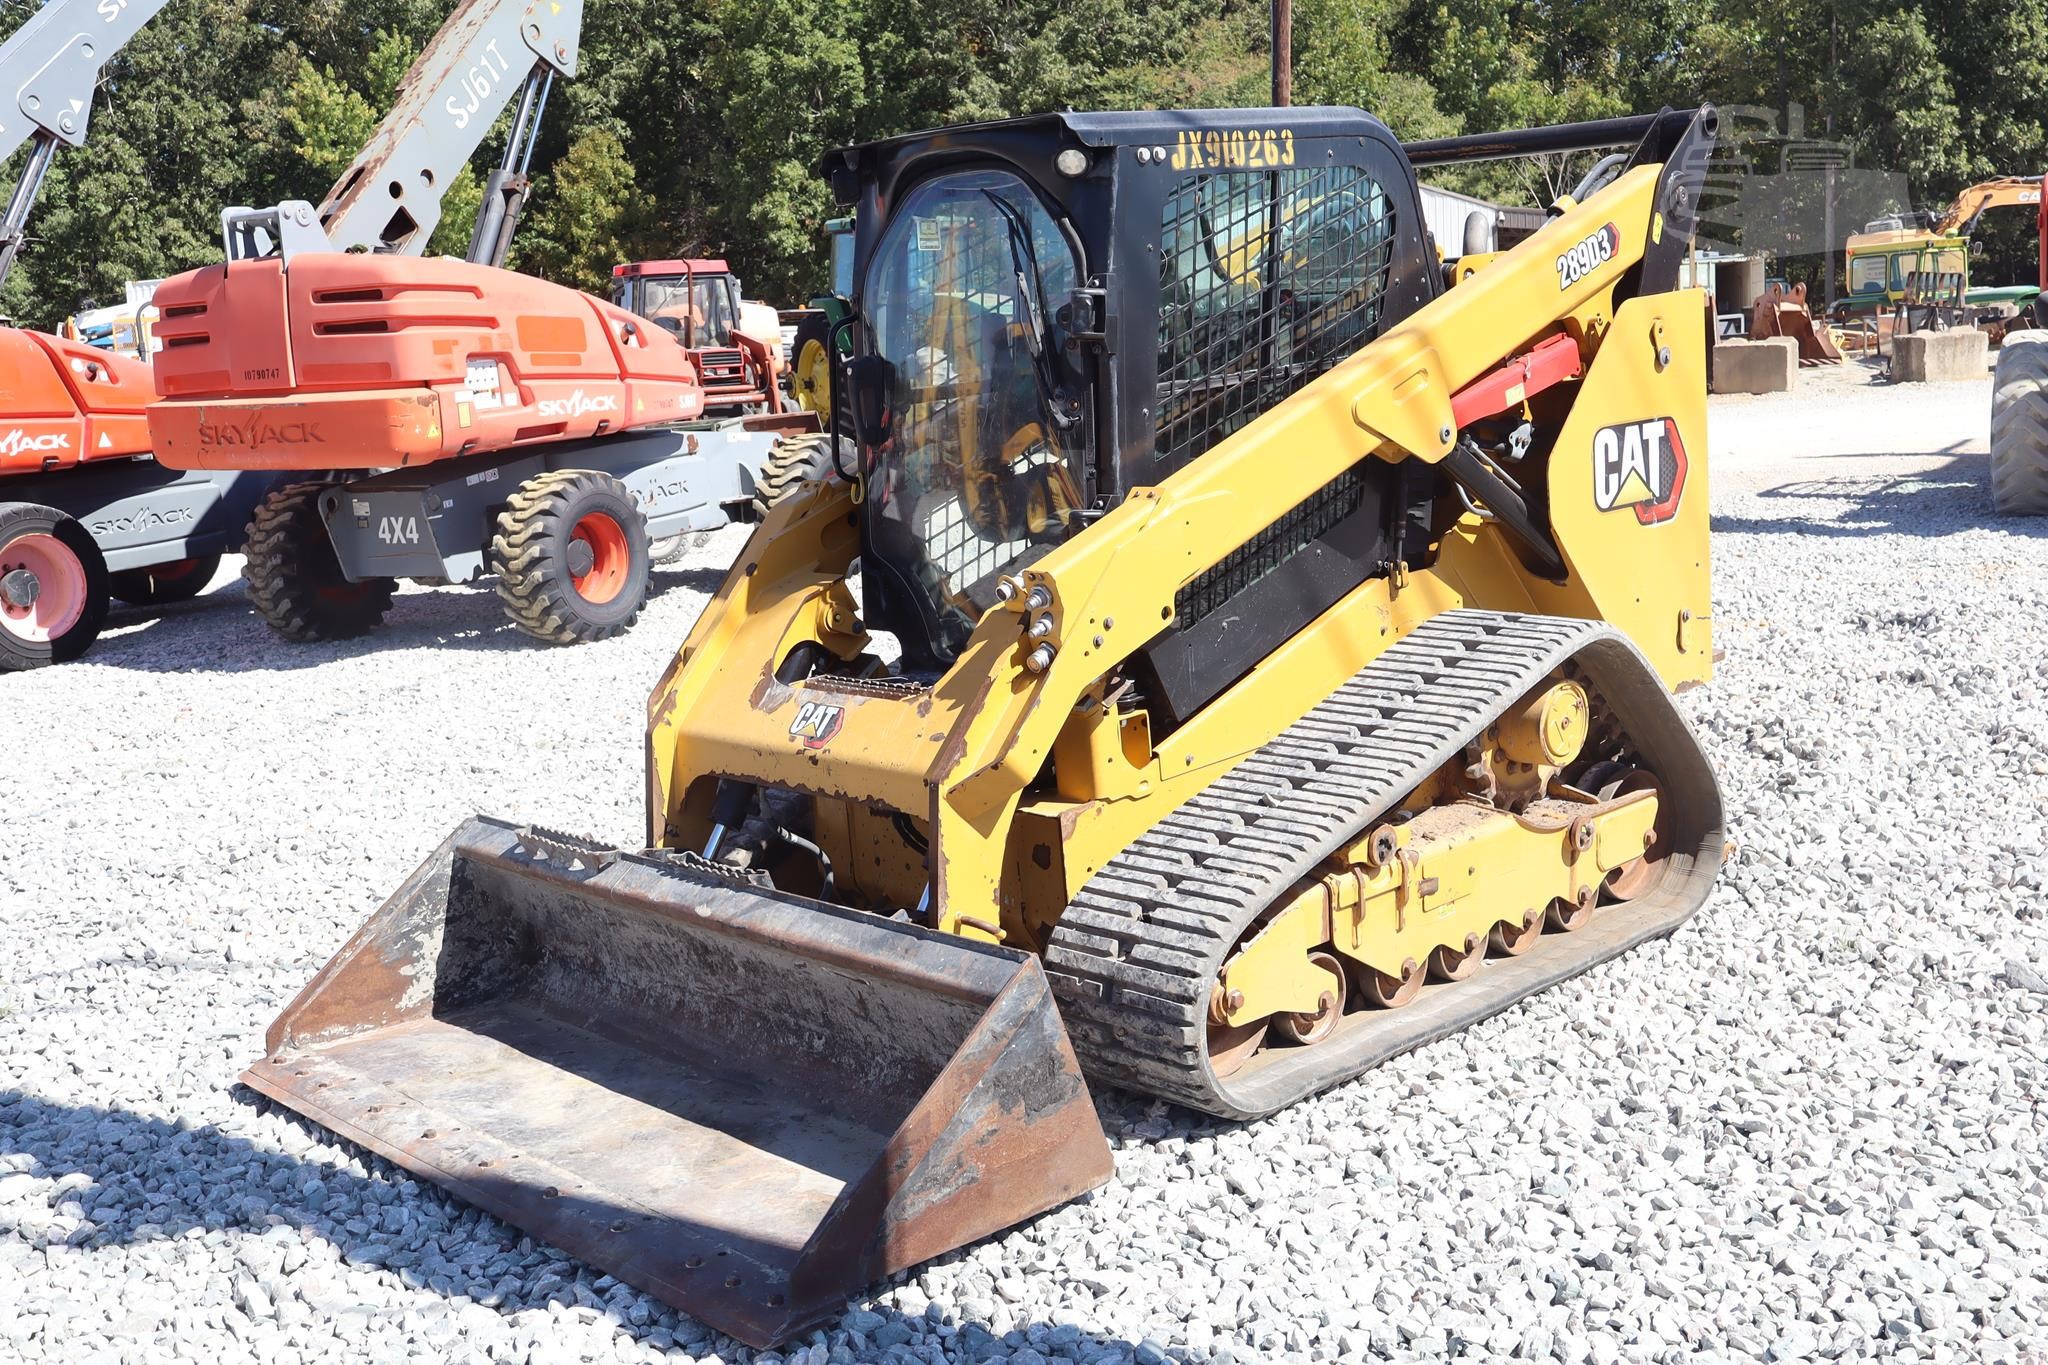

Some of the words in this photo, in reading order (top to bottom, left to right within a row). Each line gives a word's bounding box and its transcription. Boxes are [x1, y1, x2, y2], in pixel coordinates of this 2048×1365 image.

[446, 38, 509, 129] SJ61T
[1171, 128, 1296, 170] JX910263
[2018, 191, 2040, 202] CA
[1556, 228, 1612, 291] 289D3
[538, 388, 617, 418] SKYJACK
[199, 411, 325, 450] SKYJACK
[1594, 420, 1665, 509] CAT
[630, 478, 690, 505] YJACK
[92, 507, 193, 536] SKYJACK
[378, 516, 419, 544] 4X4
[790, 702, 839, 738] CAT
